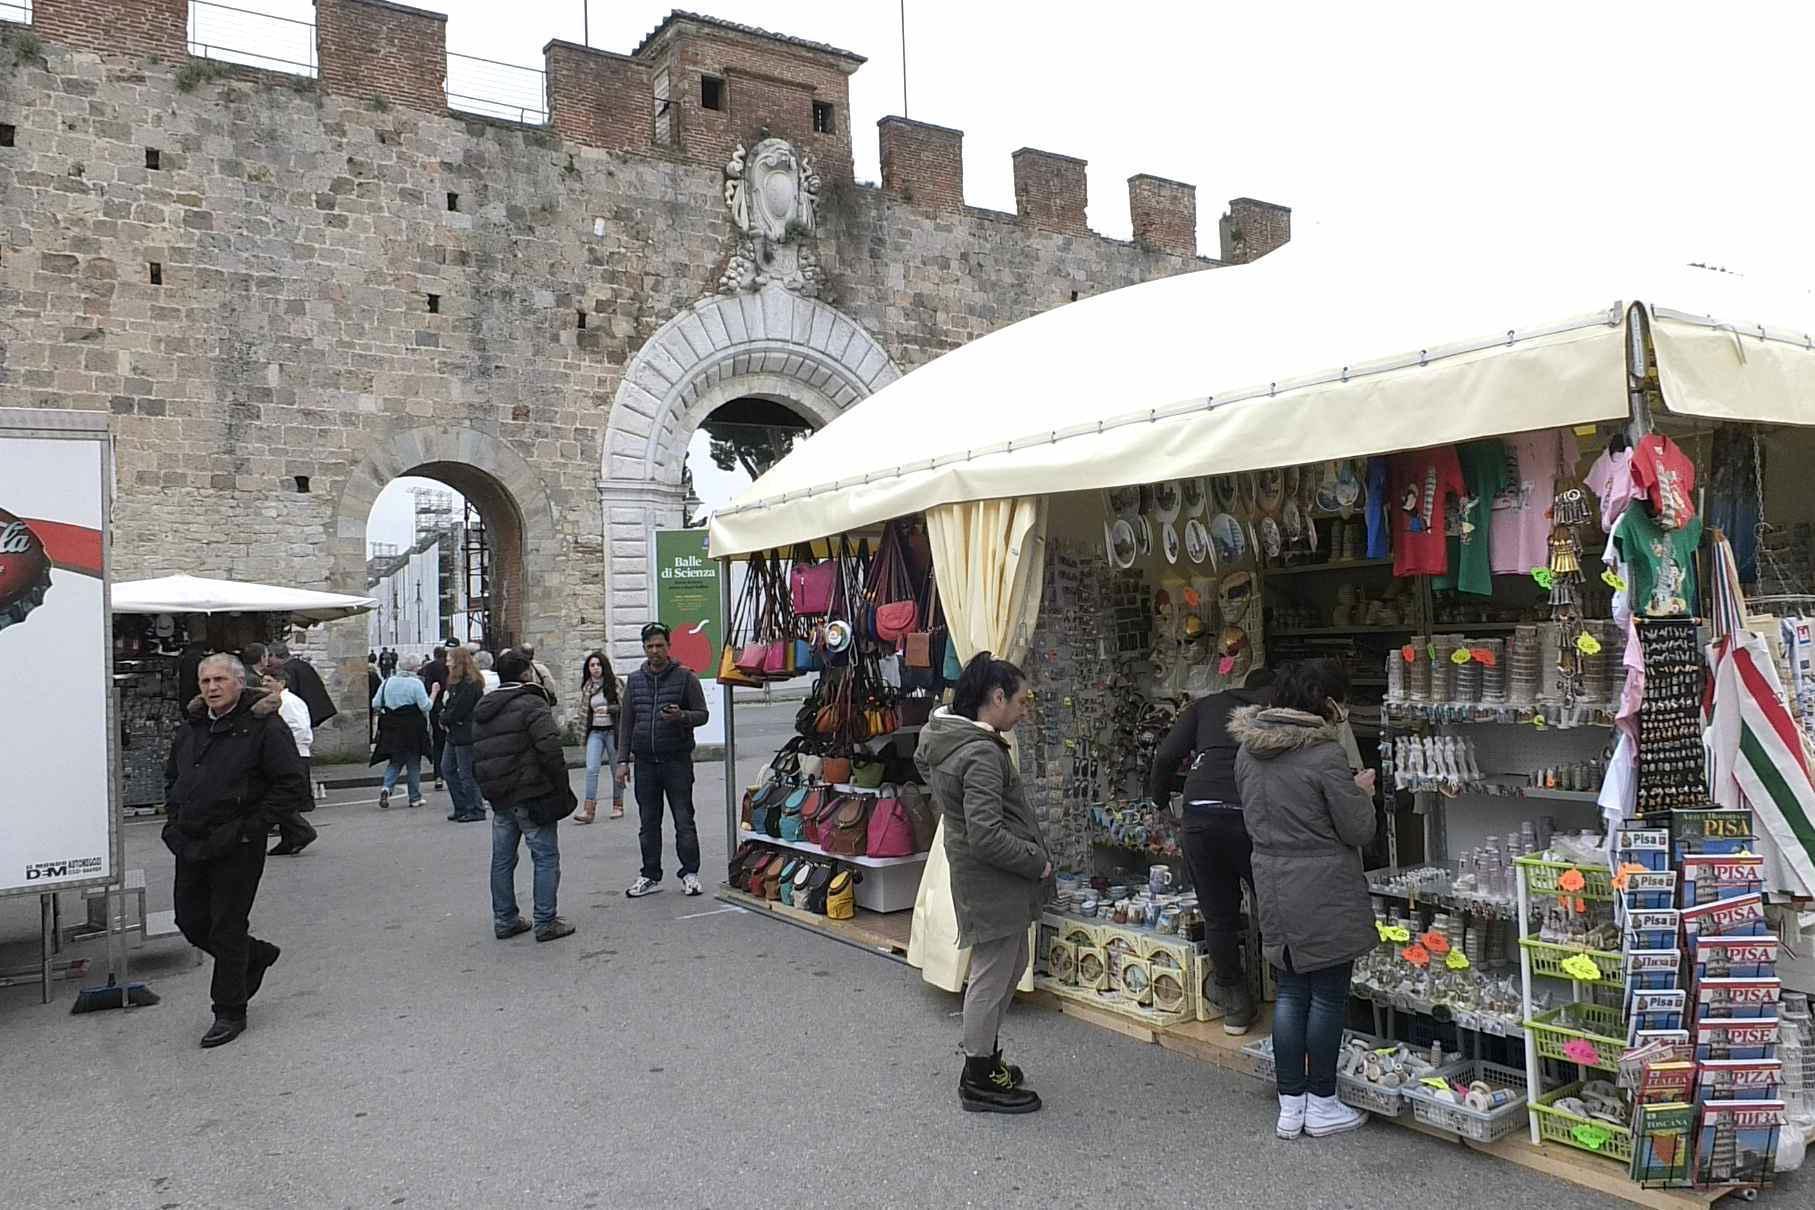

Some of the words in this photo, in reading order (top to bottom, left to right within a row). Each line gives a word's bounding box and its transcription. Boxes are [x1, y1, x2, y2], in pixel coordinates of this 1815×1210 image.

[675, 556, 702, 567] Balle
[661, 568, 672, 578] di
[674, 567, 715, 578] Scienza
[1704, 820, 1749, 836] PISA
[1633, 833, 1656, 844] Pisa
[1717, 866, 1758, 880] PISA
[1644, 915, 1667, 926] Pisa
[1716, 905, 1759, 925] PISA
[1729, 947, 1771, 960] PISA
[1732, 989, 1773, 1001] PISA
[1650, 998, 1673, 1007] Pisa
[1731, 1030, 1772, 1042] PISE
[1733, 1071, 1776, 1084] PIZA
[1647, 1119, 1688, 1129] TOSCANA
